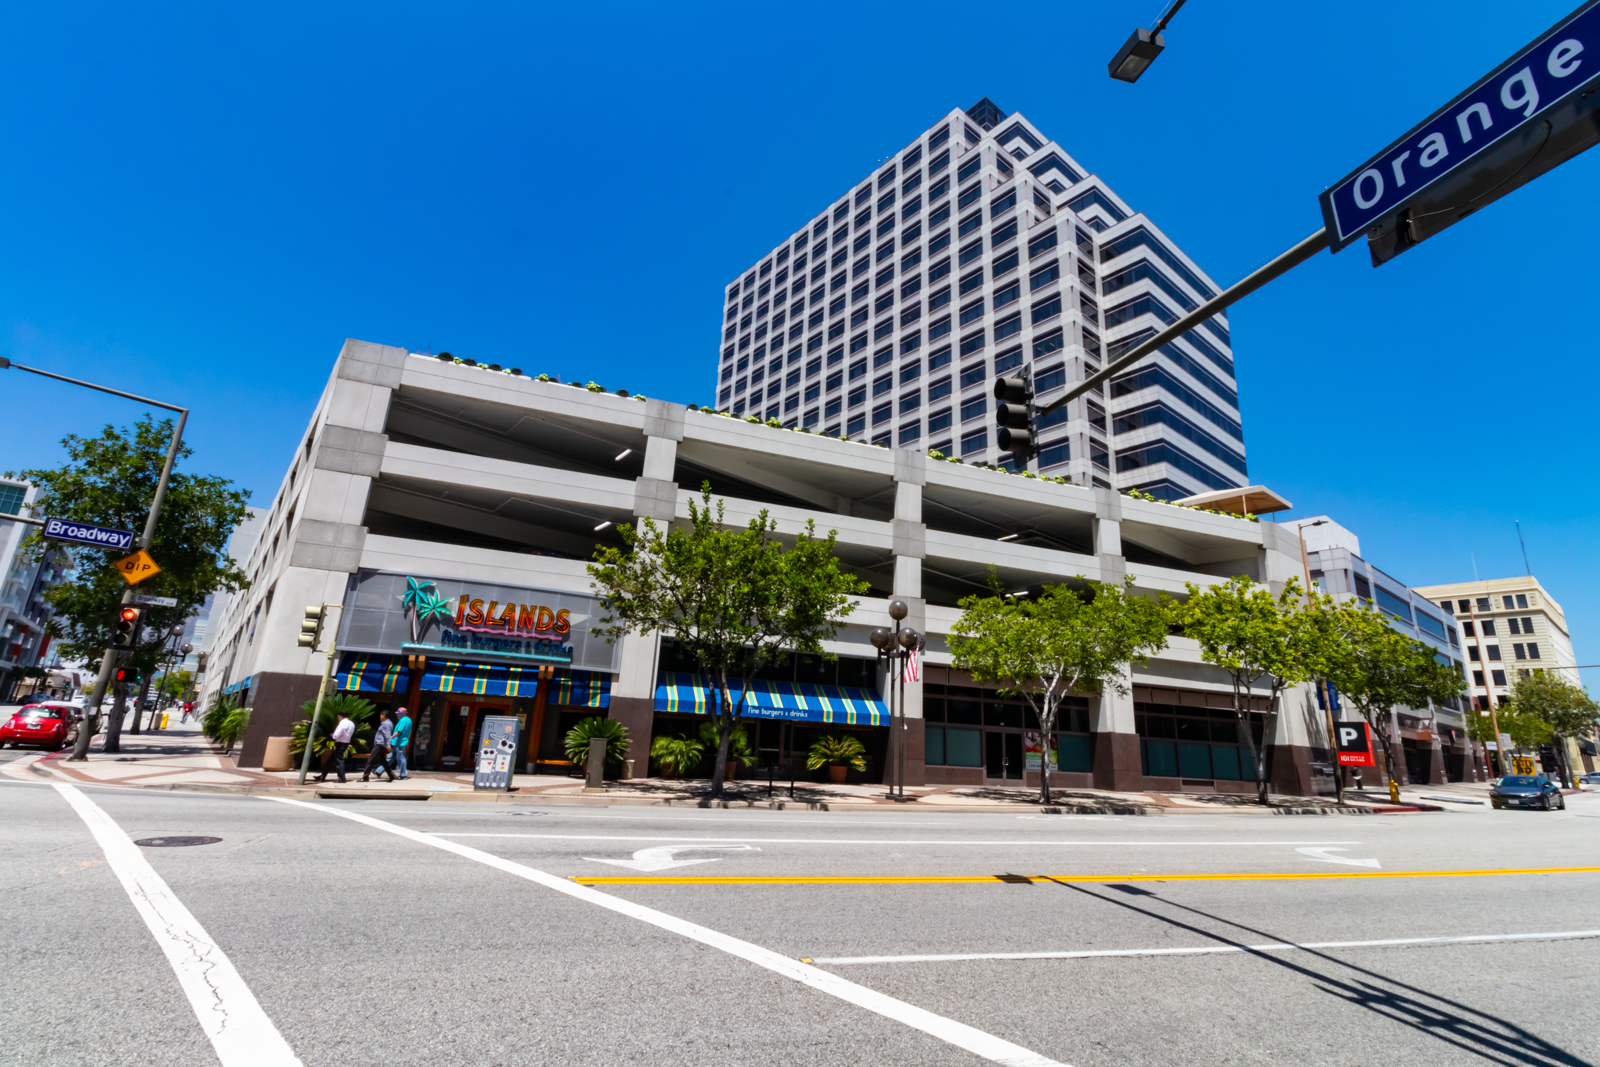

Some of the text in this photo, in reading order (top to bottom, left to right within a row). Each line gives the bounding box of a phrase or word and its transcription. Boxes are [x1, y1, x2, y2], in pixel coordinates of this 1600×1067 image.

[1353, 38, 1584, 210] Orange
[48, 520, 130, 547] Broadway
[125, 561, 151, 572] DIP
[137, 595, 166, 604] Broadway
[453, 593, 571, 634] ISLANDS
[441, 629, 468, 643] fine
[471, 633, 521, 649] burgers
[534, 641, 573, 654] drinks
[747, 706, 760, 714] fine
[761, 708, 784, 717] burgers
[790, 710, 808, 718] drinks
[1340, 727, 1358, 747] P
